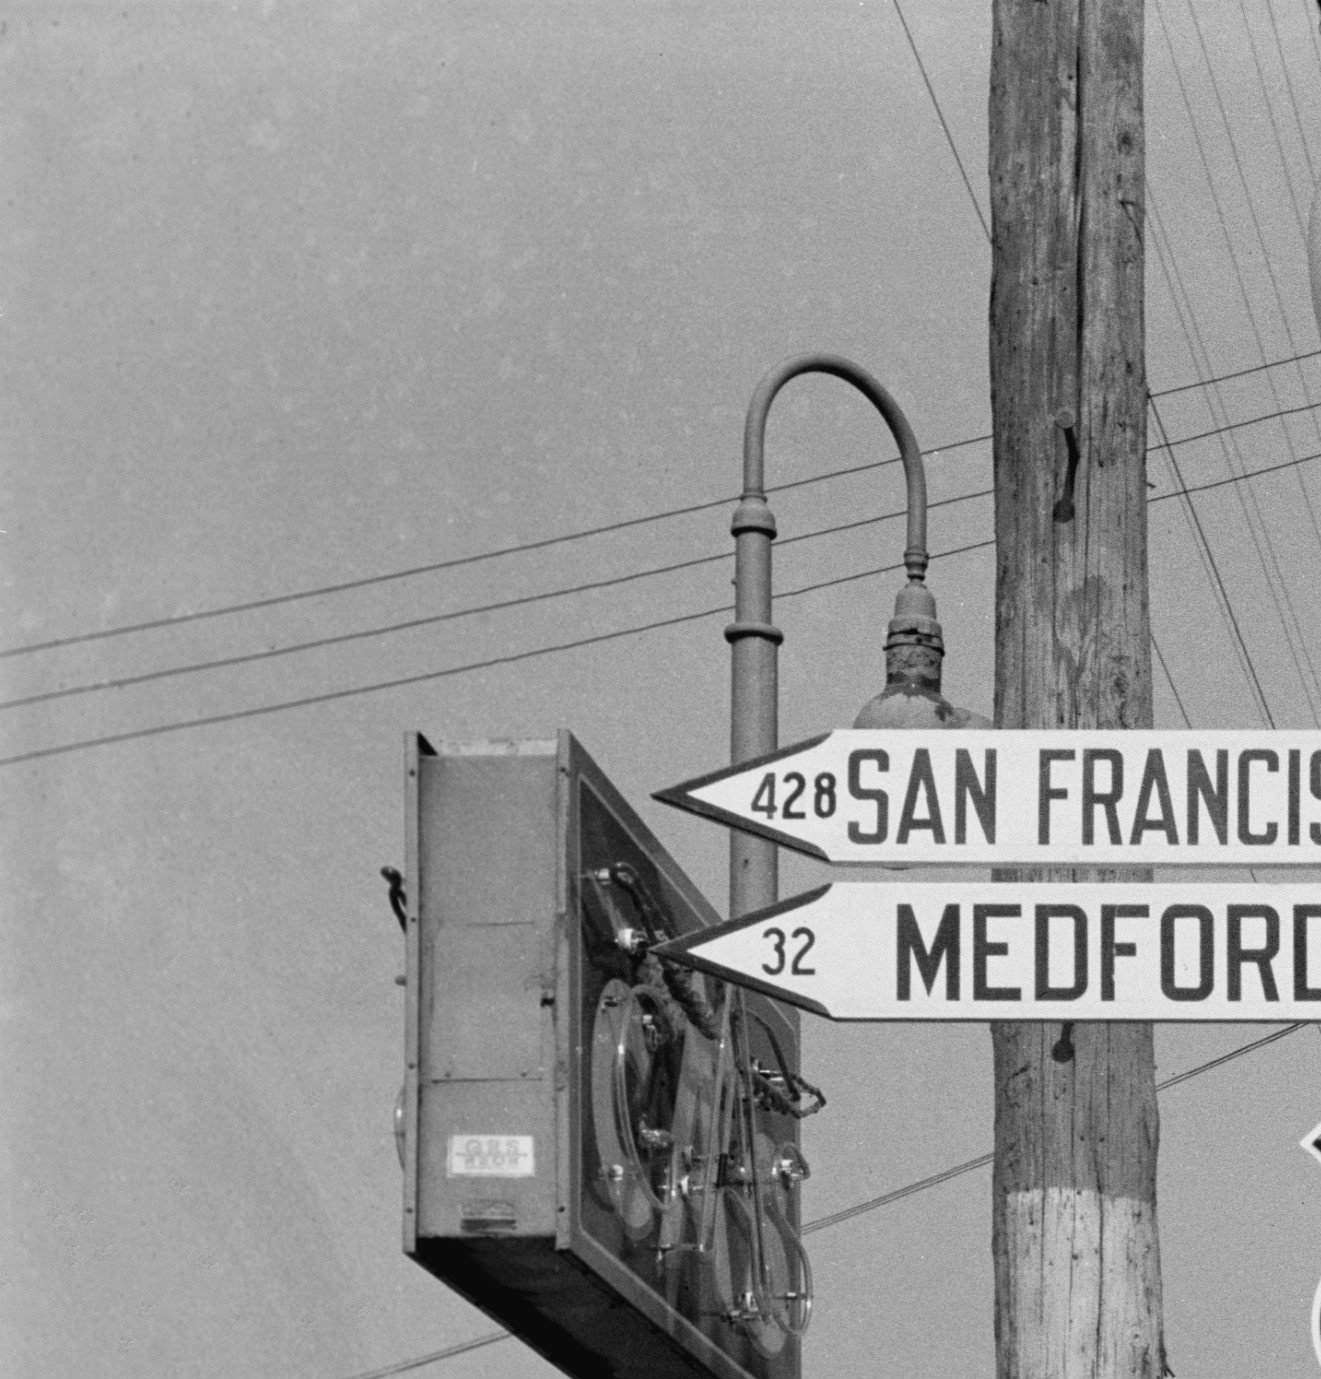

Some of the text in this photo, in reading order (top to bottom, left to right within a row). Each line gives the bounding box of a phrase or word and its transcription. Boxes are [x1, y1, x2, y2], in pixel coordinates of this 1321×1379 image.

[751, 772, 837, 820] 428
[846, 748, 998, 846] SAN
[760, 926, 817, 977] 32
